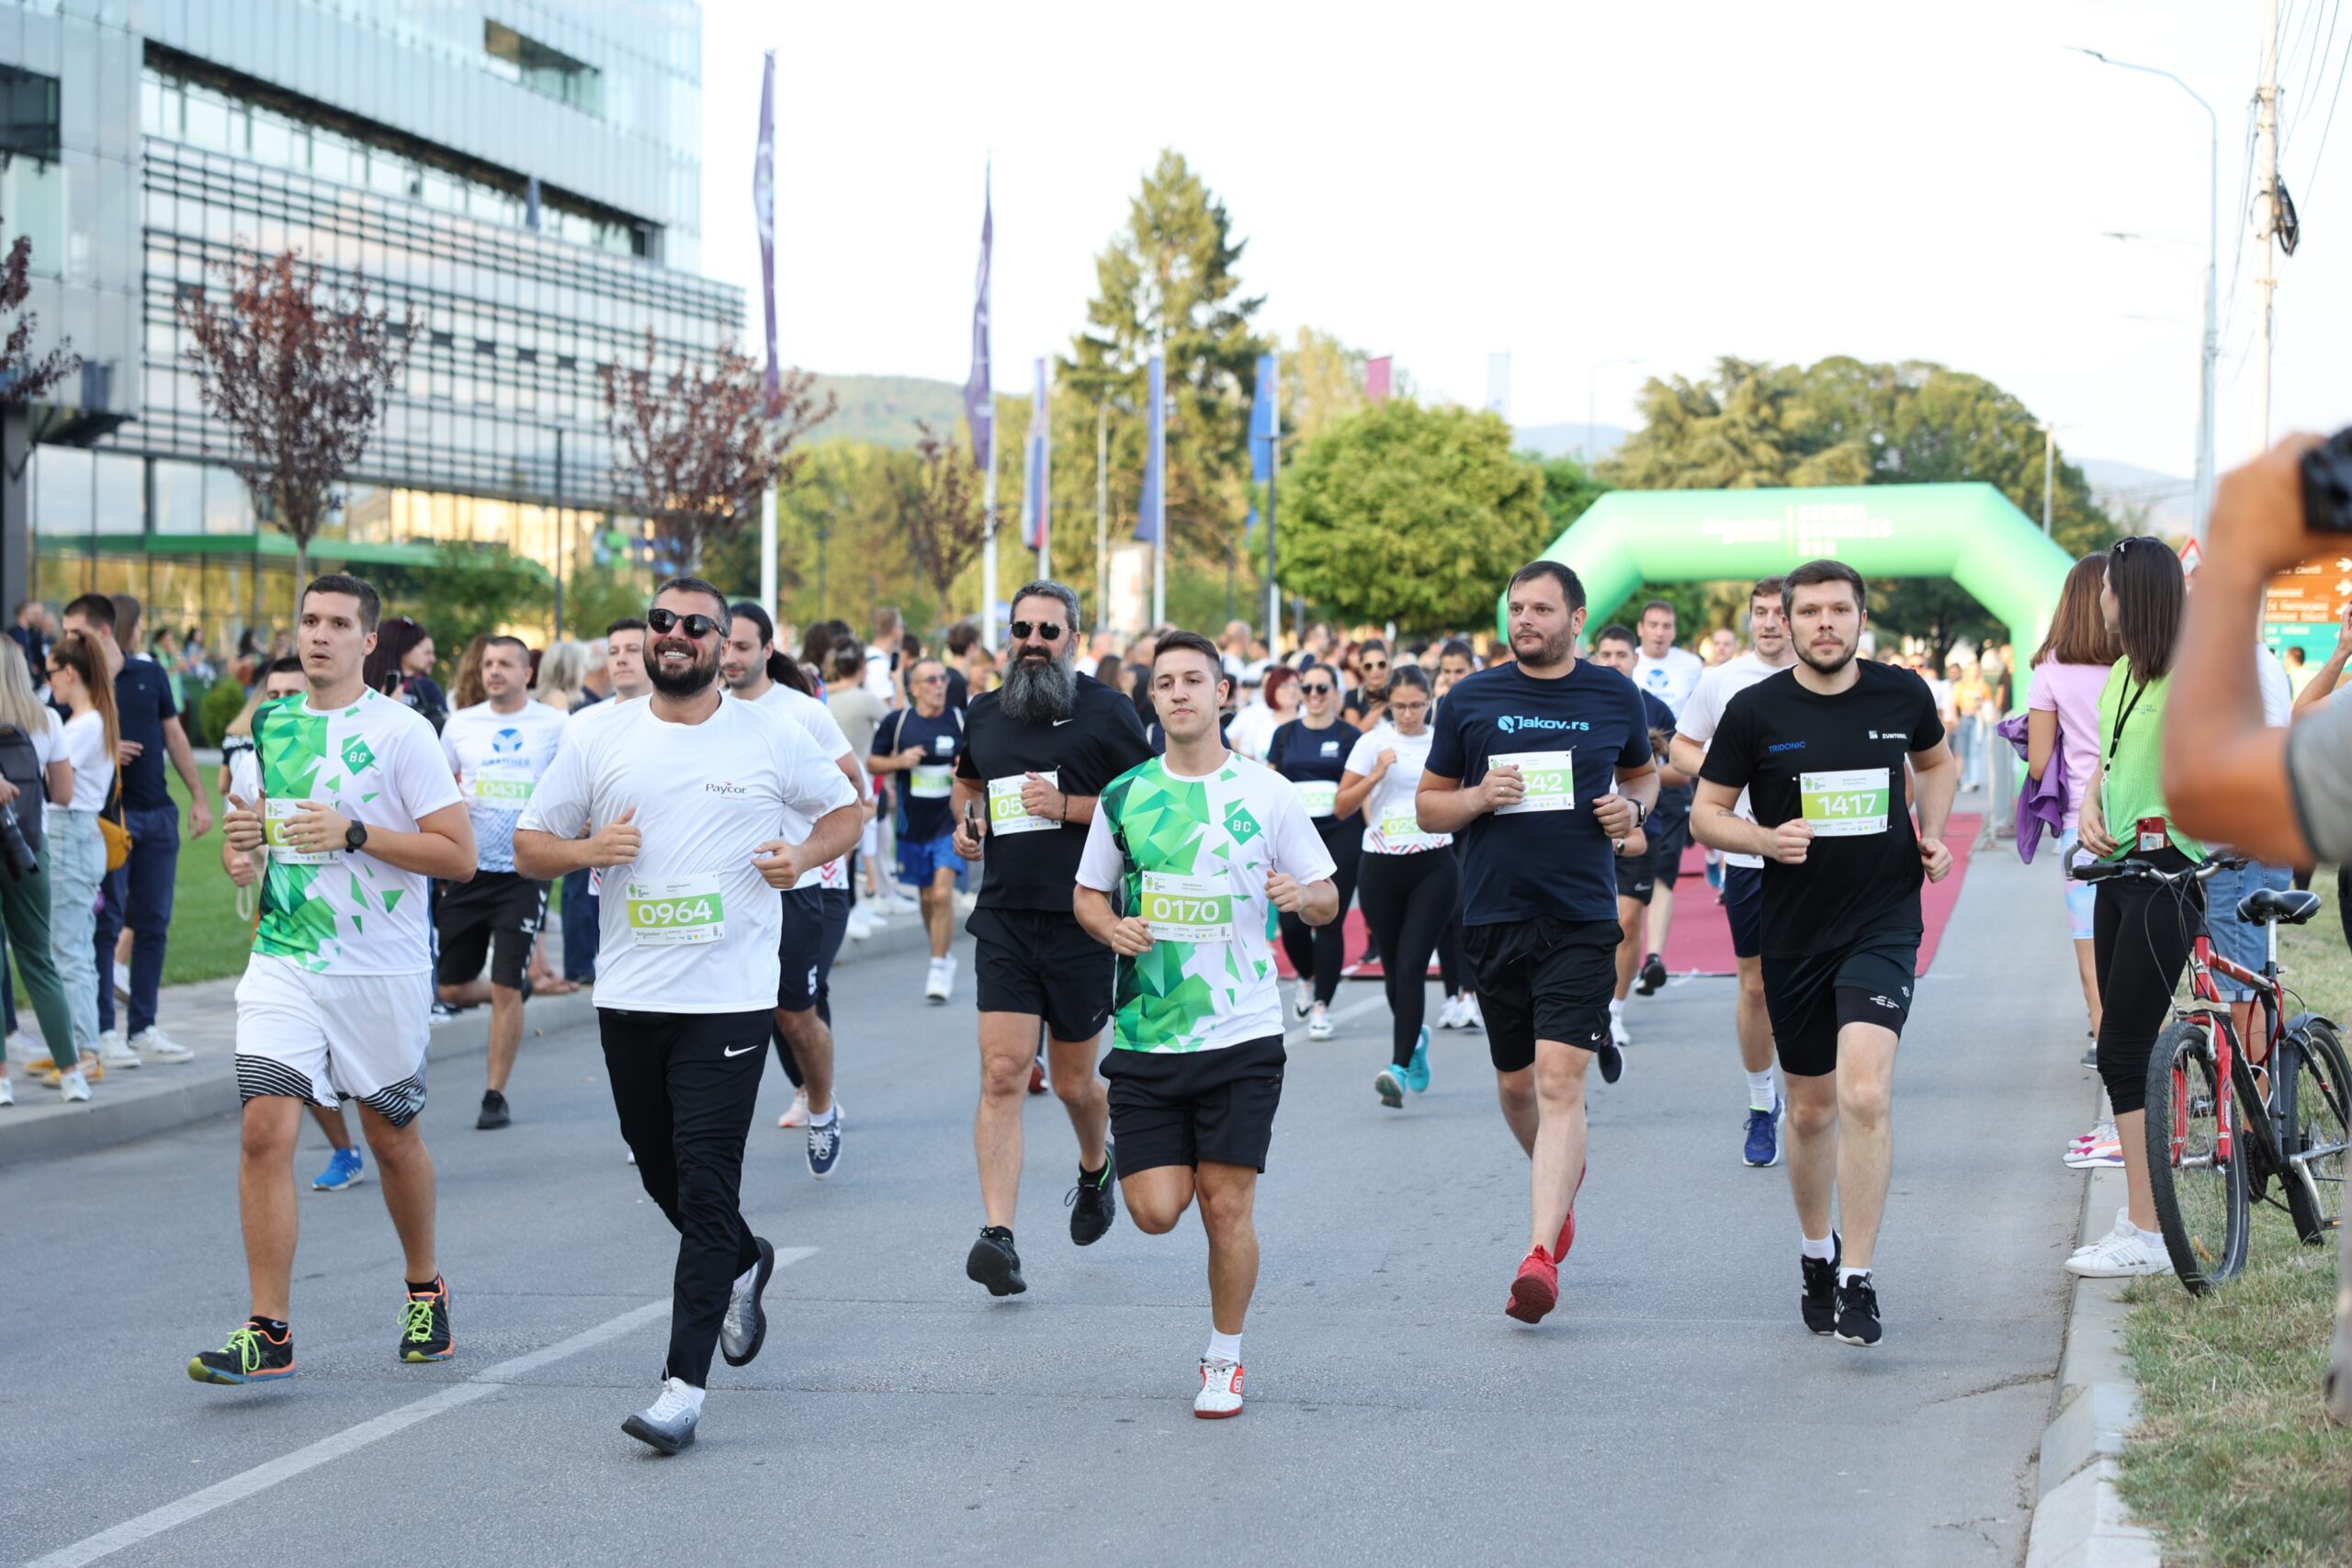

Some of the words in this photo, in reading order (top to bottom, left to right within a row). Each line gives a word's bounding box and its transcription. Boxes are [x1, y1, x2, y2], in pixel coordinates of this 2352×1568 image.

[1769, 741, 1805, 753] TRIDONIC
[349, 751, 367, 763] BC
[706, 783, 747, 795] Paycor
[1817, 793, 1877, 817] 1417
[1232, 820, 1251, 833] BC
[638, 898, 713, 925] 0964
[1153, 897, 1220, 922] 0170
